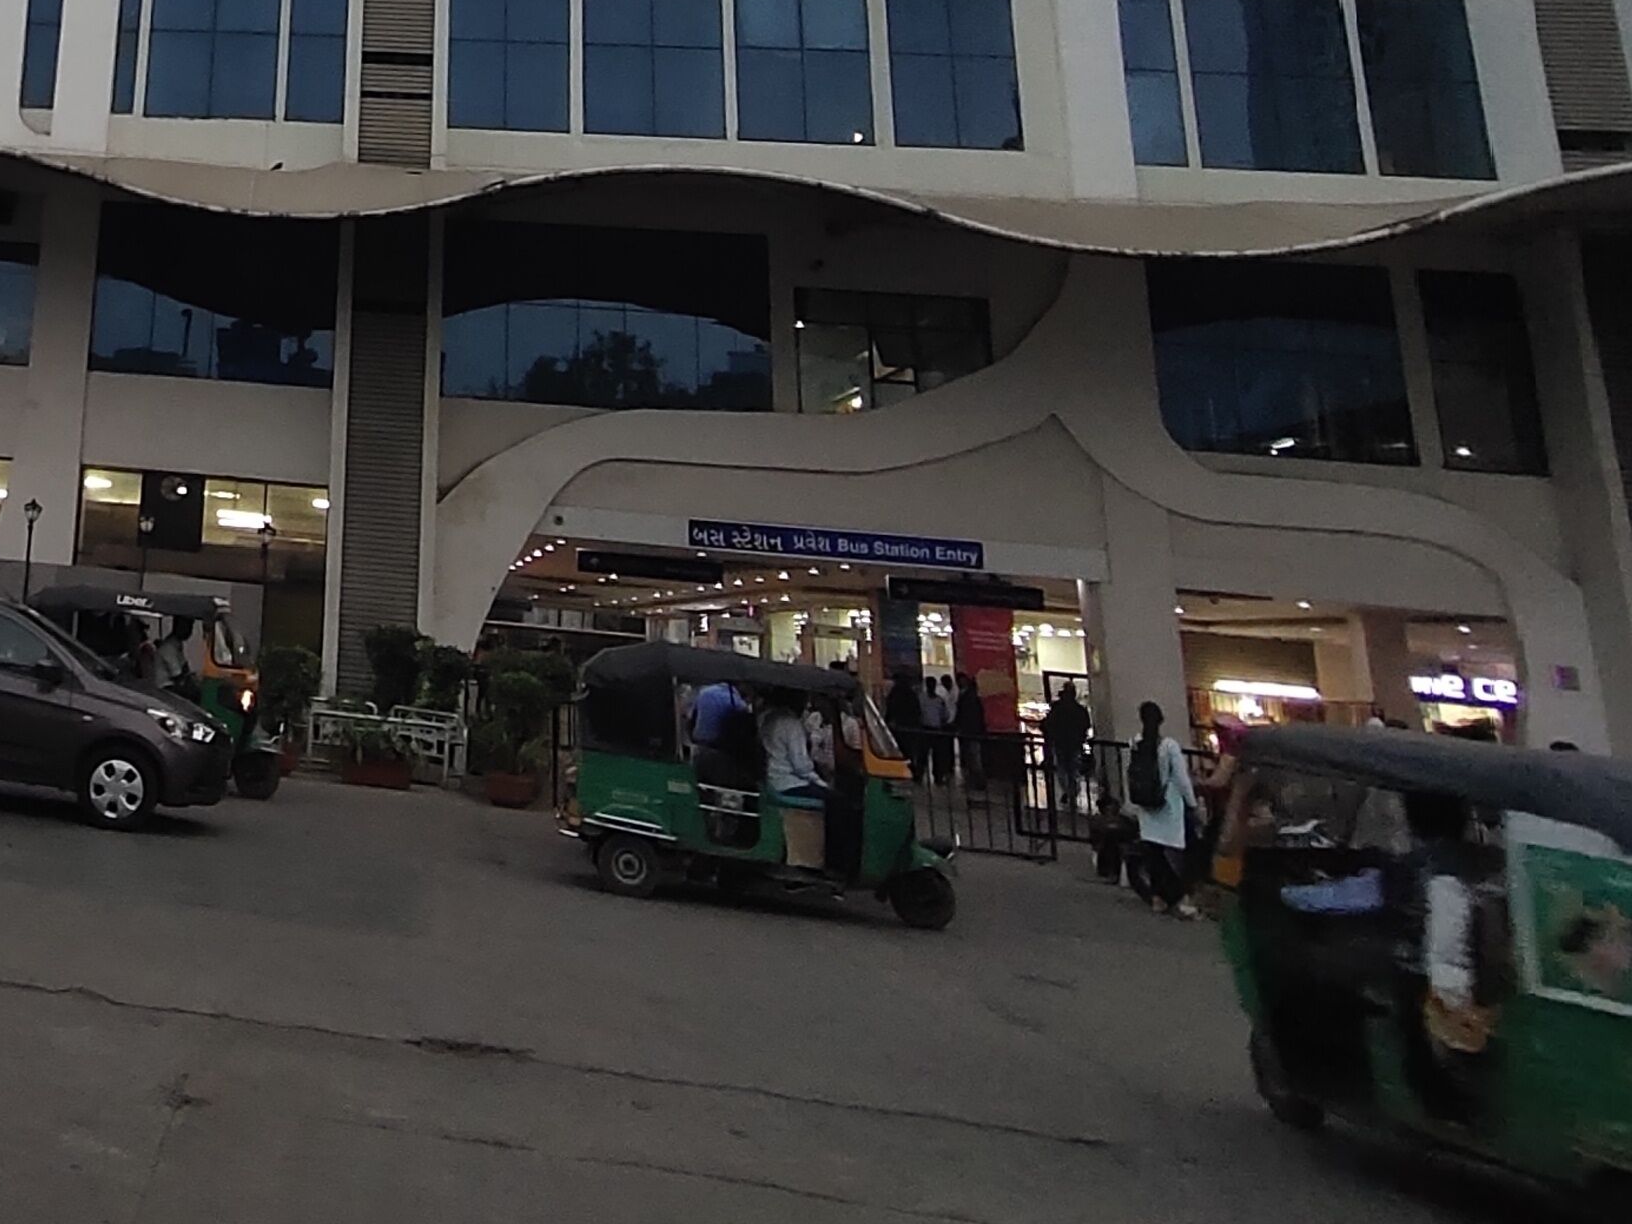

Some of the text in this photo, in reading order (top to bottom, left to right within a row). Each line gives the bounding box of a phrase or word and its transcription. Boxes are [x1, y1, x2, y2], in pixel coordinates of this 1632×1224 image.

[692, 526, 832, 553] બસ સ્ટેશન પ્રવેશ
[837, 538, 979, 566] Bus Station Entry
[116, 595, 148, 607] Uber
